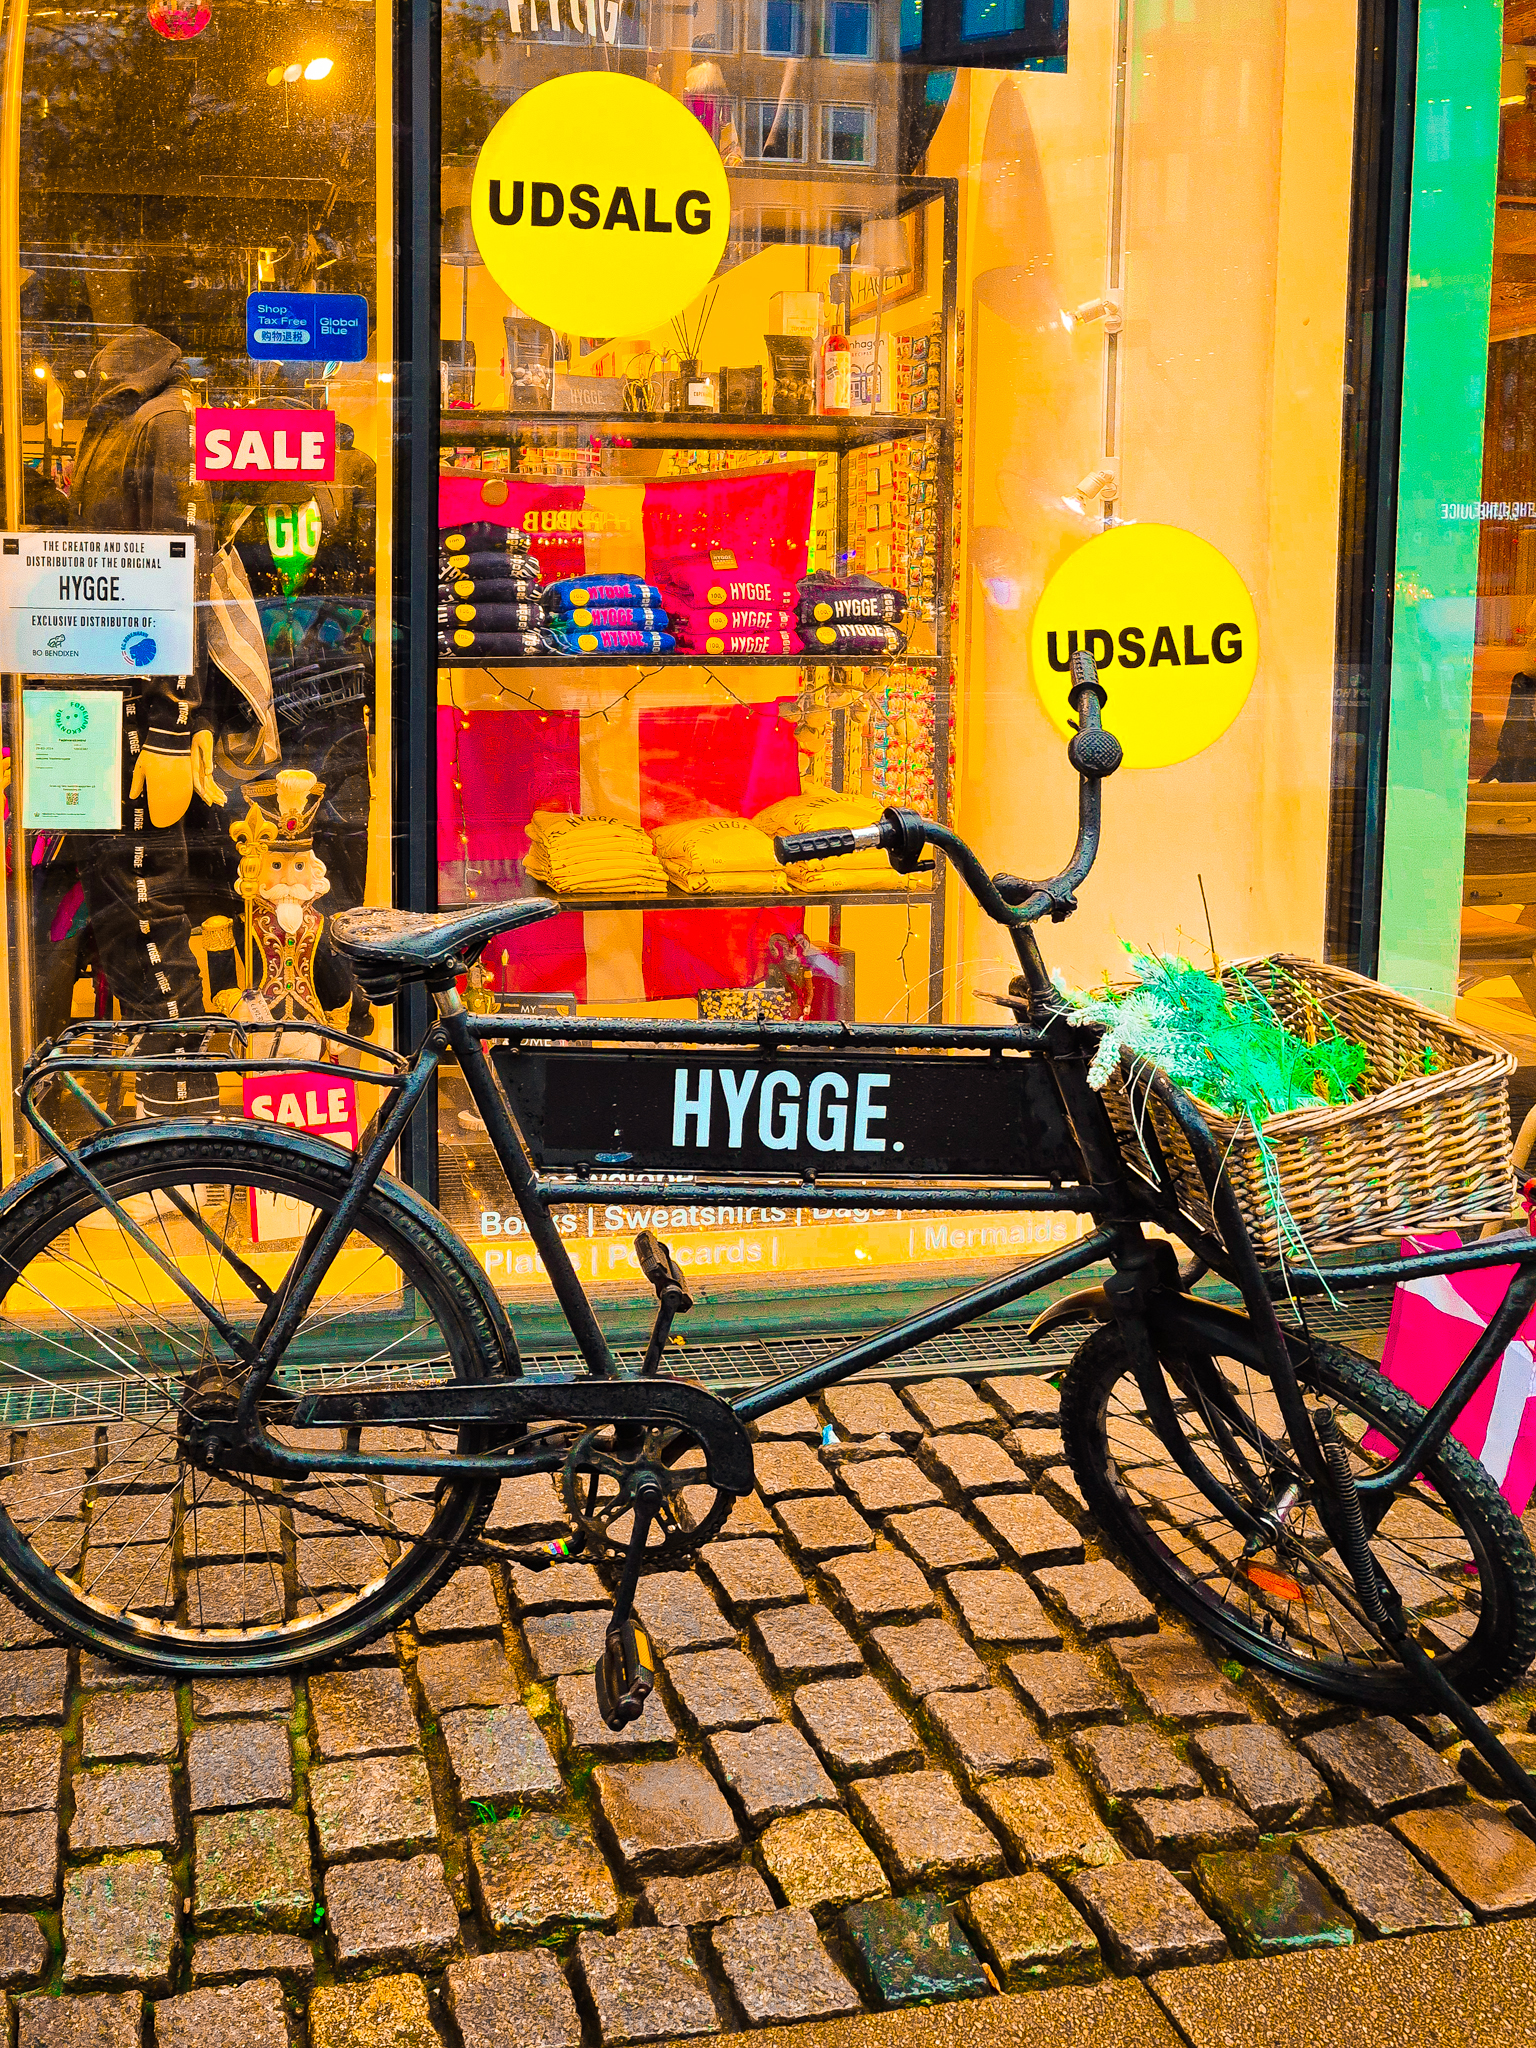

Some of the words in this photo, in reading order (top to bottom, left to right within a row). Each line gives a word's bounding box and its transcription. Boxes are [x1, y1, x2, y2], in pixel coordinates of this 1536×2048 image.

[489, 179, 712, 236] UDSALG
[257, 304, 288, 315] Shop
[258, 316, 277, 326] Tax
[280, 316, 307, 326] Free
[319, 317, 359, 327] Global
[261, 330, 303, 343] 购物退税
[321, 326, 348, 335] Blue
[204, 429, 326, 471] SALE
[43, 541, 59, 552] THE
[62, 541, 101, 552] CREATOR
[104, 542, 121, 553] AND
[124, 542, 145, 554] SOLE
[26, 556, 85, 568] DISTRIBUTOR
[88, 557, 99, 568] OF
[102, 557, 118, 568] THE
[121, 558, 162, 569] ORIGINAL
[59, 575, 125, 602] HYGGE.
[834, 598, 882, 618] HYGGE.
[31, 615, 78, 627] EXCLUSIVE
[80, 616, 139, 628] DISTRIBUTOR
[141, 616, 156, 628] OF:
[732, 611, 773, 629] HYGGE
[730, 636, 770, 654] HYGGE
[1046, 621, 1244, 673] UDSALG
[520, 1005, 537, 1014] MY
[251, 1088, 349, 1129] SALE
[672, 1067, 905, 1153] HYGGE.
[481, 1211, 578, 1236] Bos
[485, 1249, 581, 1275] Plats
[608, 1238, 762, 1270] Pocards
[926, 1218, 1068, 1250] Mermaids
